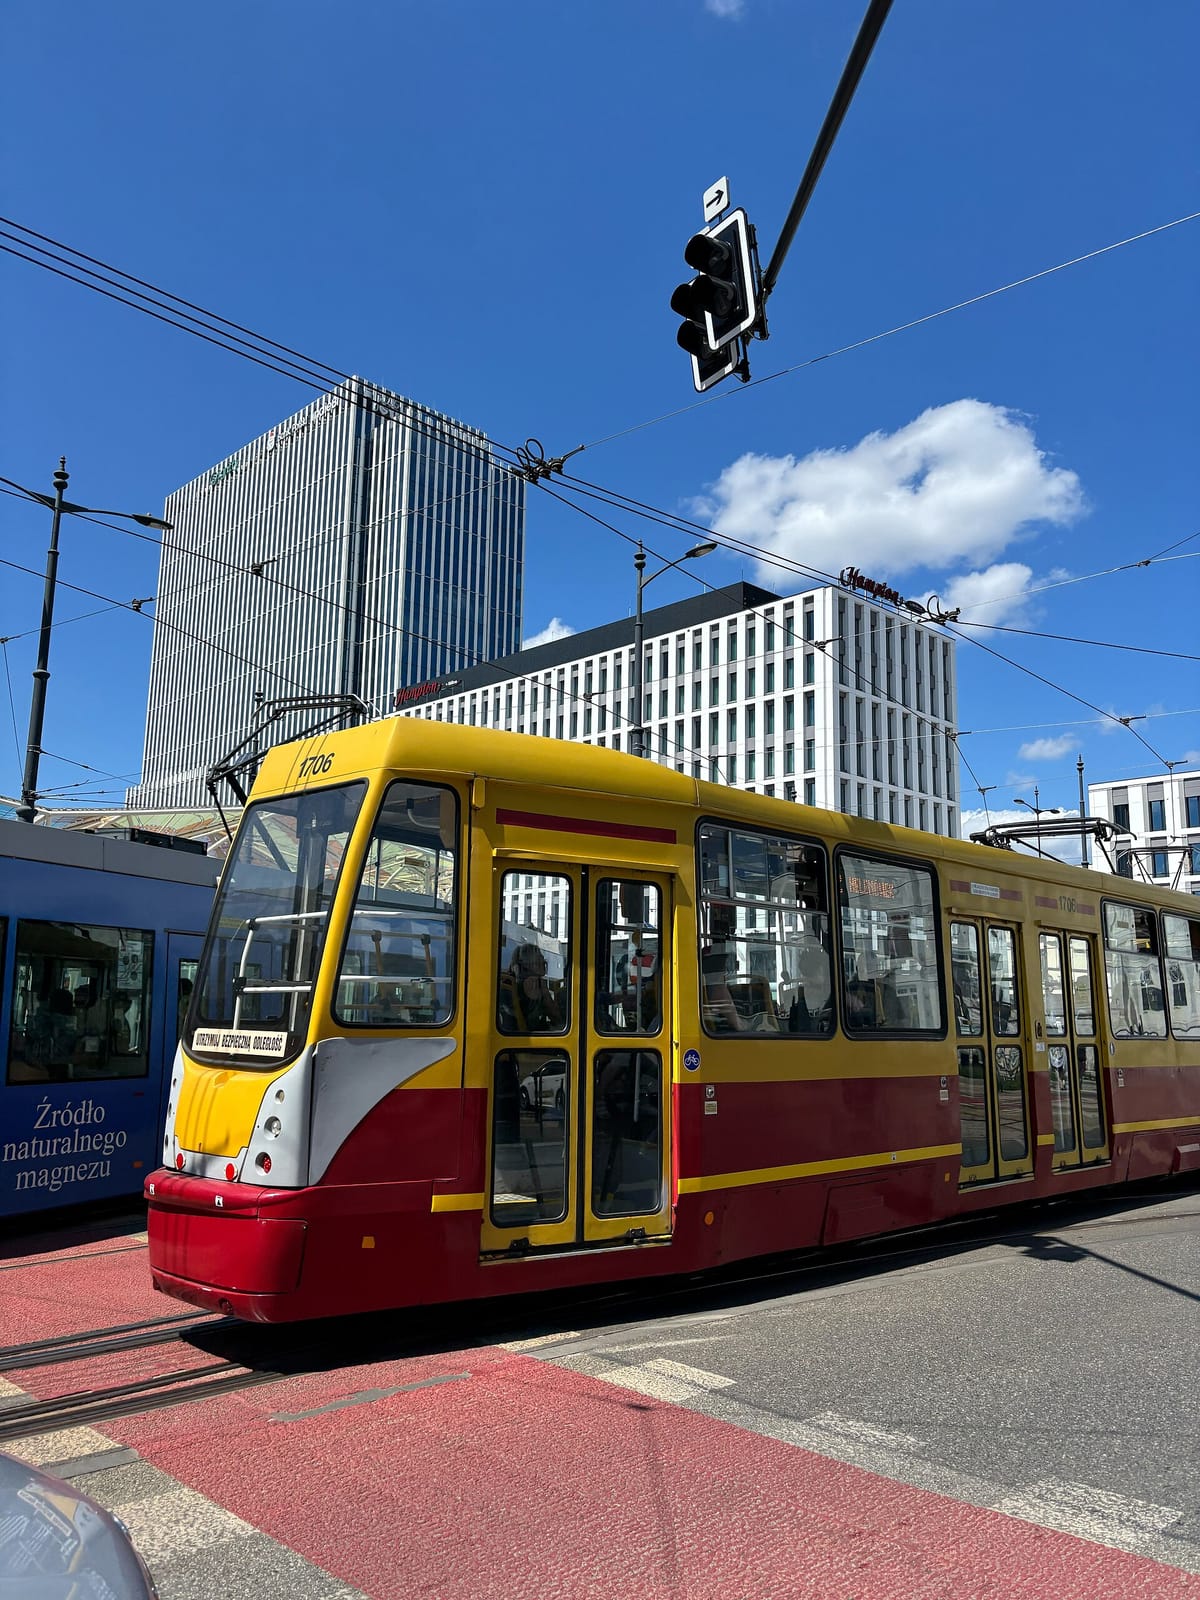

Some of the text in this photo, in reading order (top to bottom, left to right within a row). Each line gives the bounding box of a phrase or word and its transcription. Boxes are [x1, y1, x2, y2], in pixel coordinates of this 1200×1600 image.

[840, 566, 905, 606] Hampton
[394, 681, 442, 706] Hampton
[298, 752, 335, 778] 1706
[1057, 895, 1077, 913] 1706
[196, 1032, 283, 1052] UTRZYMUJ BEZPIECZNĄ ODLEGŁOŚĆ
[33, 1095, 106, 1129] Źródło
[1, 1128, 127, 1162] naturalnego
[15, 1160, 111, 1192] magnezu
